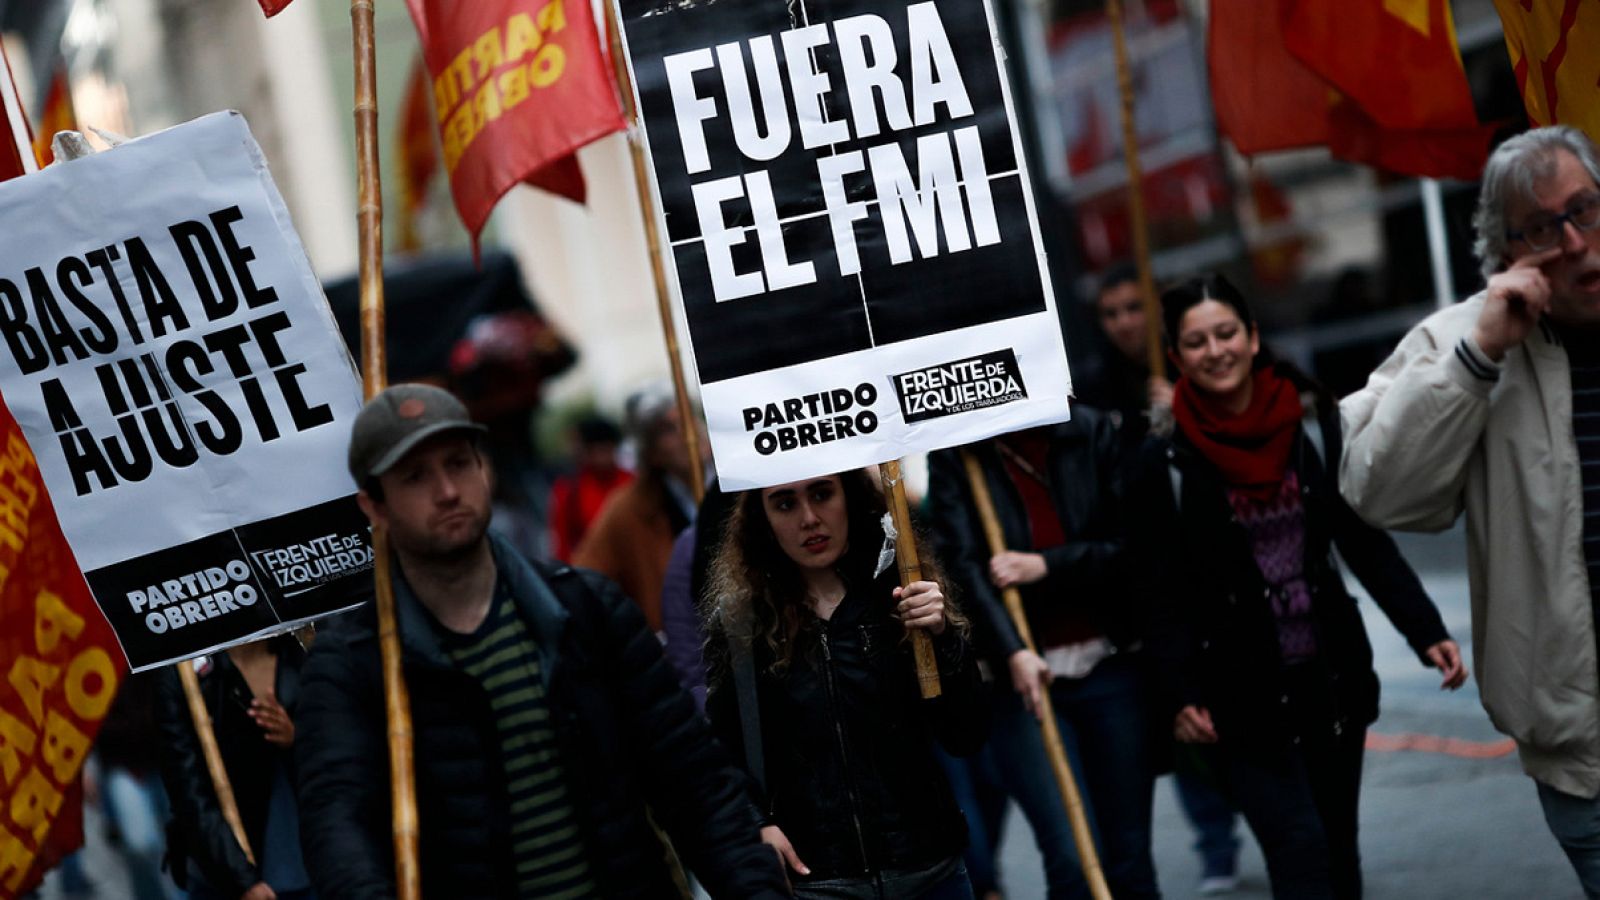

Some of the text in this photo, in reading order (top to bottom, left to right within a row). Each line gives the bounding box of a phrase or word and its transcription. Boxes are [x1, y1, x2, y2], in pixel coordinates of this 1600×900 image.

[663, 1, 974, 174] FUERA
[691, 125, 1002, 302] EL FMI
[0, 204, 280, 376] BASTA DE
[900, 359, 1006, 395] FRENTE DE
[904, 375, 1022, 415] IZQUIERDA
[40, 310, 335, 496] AJUSTE
[742, 382, 877, 432] PARTIDO
[754, 410, 878, 455] OBRERO
[263, 533, 362, 570] FRENTE DE
[126, 559, 250, 614] PARTIDO
[145, 584, 258, 634] OBRERO
